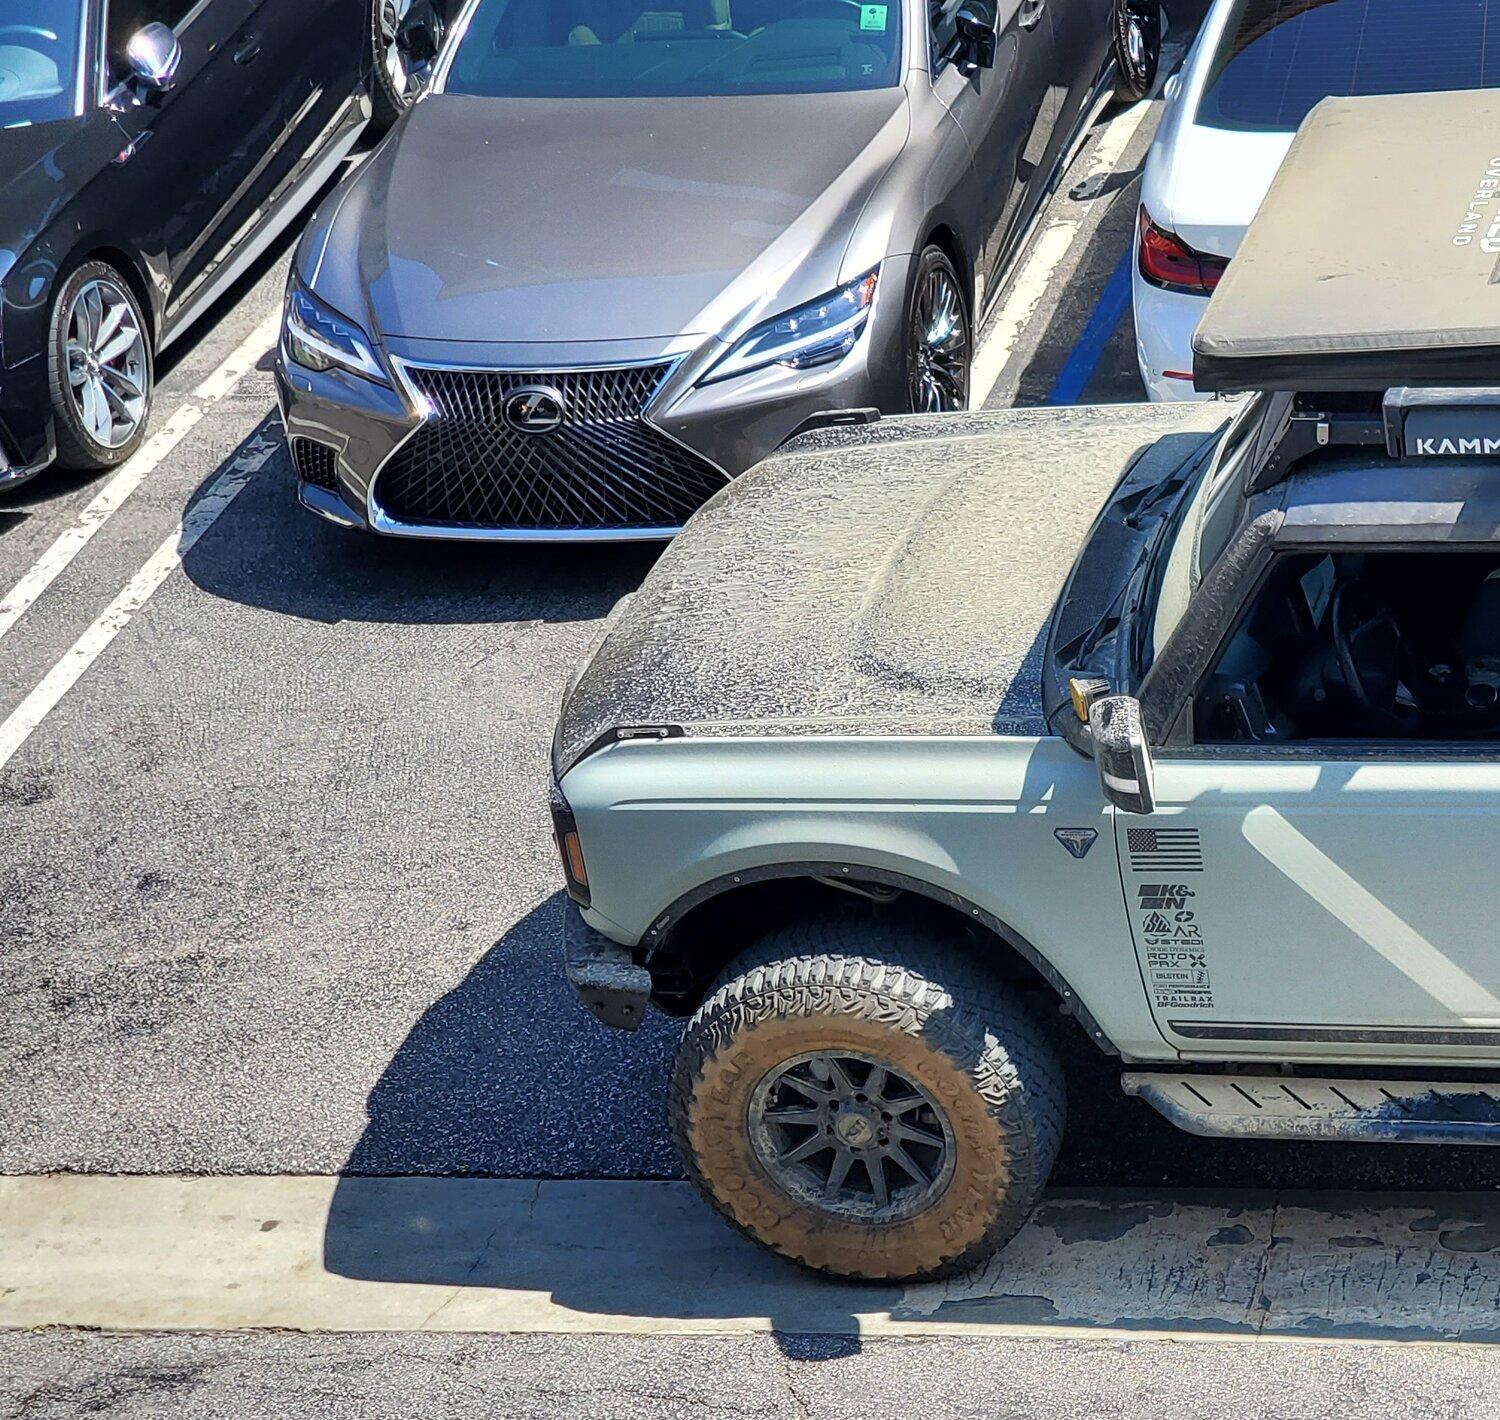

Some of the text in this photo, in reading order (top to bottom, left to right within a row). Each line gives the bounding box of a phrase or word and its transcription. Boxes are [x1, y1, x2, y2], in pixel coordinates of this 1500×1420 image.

[1147, 952, 1188, 960] ROTO
[1148, 960, 1181, 968] PAX
[1155, 972, 1189, 980] BILSTEIN
[1156, 1001, 1215, 1009] BFGoodrich
